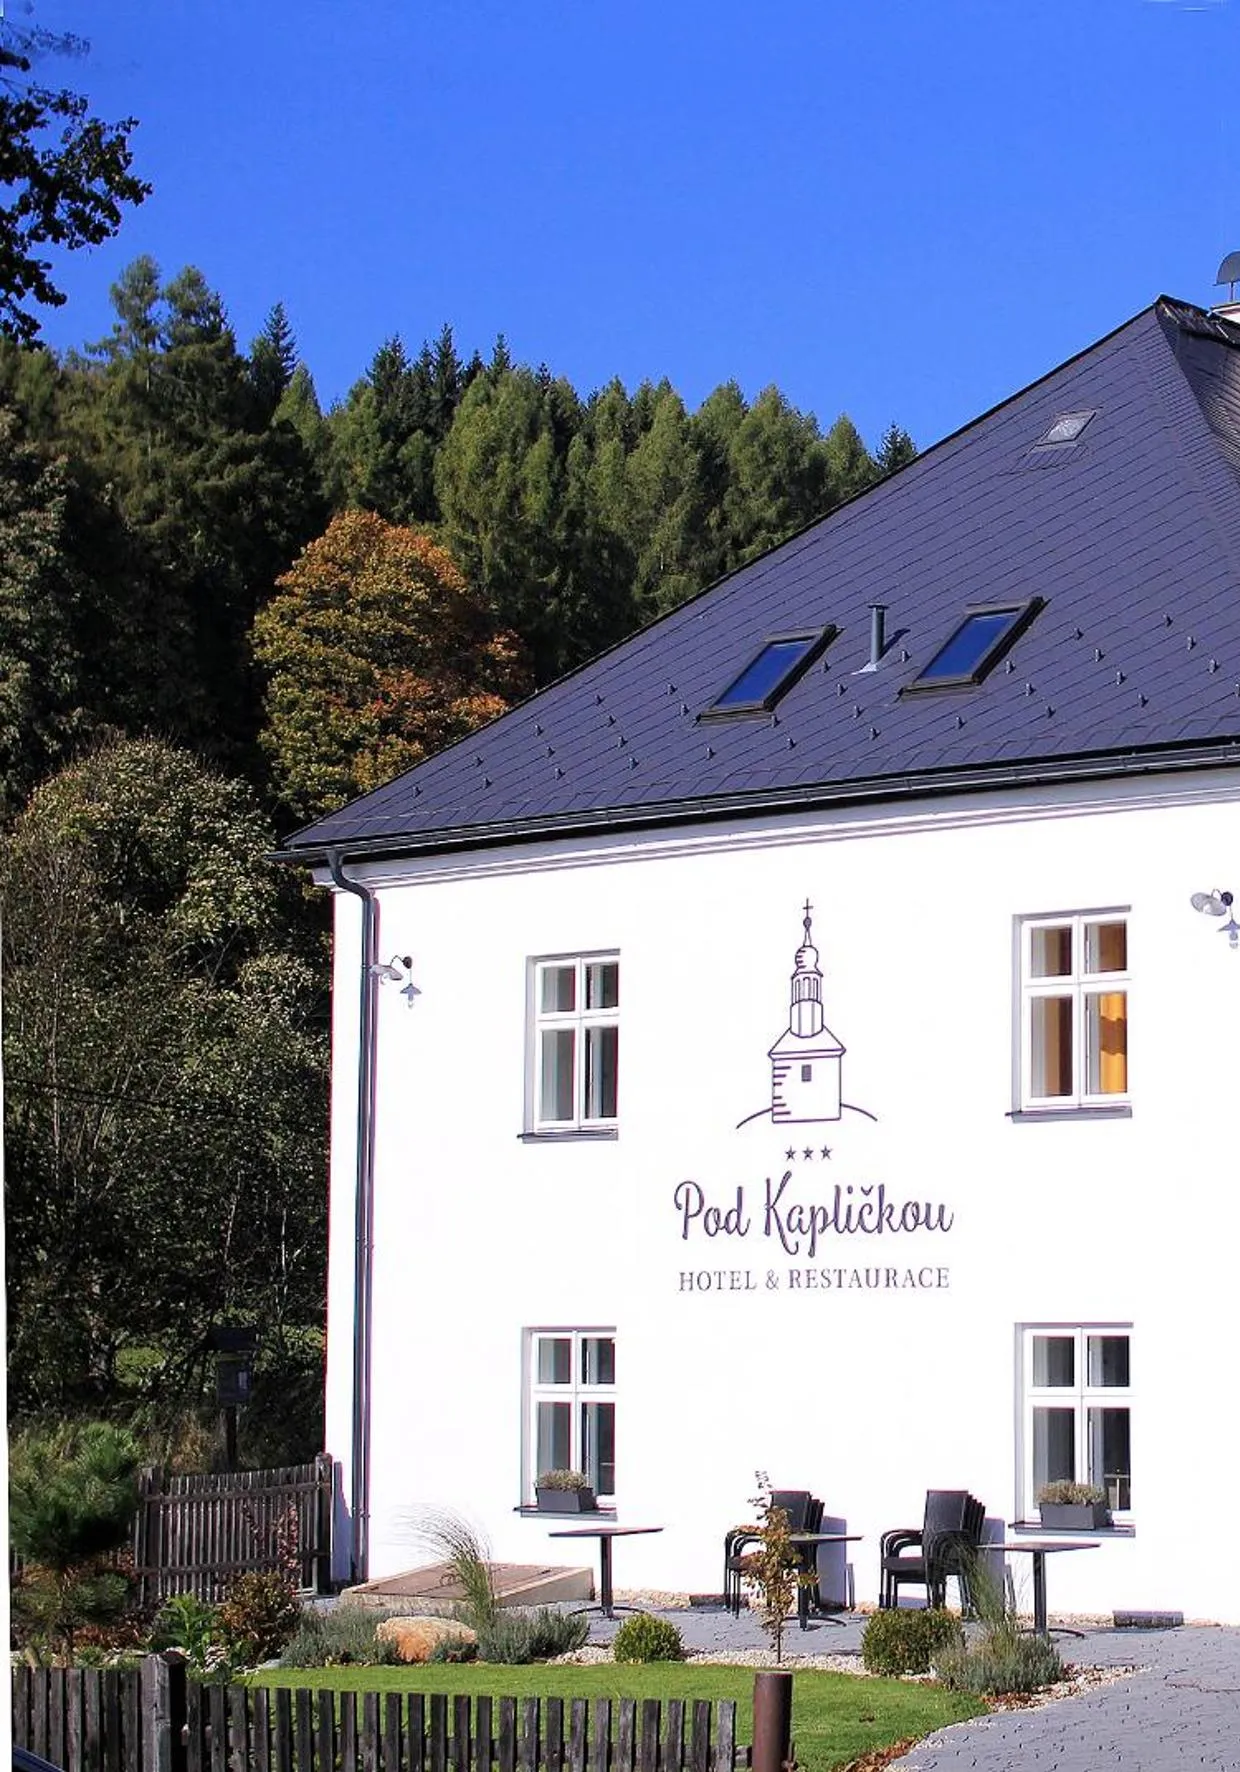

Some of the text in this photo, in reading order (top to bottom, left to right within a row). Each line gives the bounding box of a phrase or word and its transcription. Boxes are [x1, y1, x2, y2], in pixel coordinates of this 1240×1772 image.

[673, 1169, 954, 1259] Pod Kapličkou
[679, 1267, 950, 1291] HOTEL & RESTAURACE
